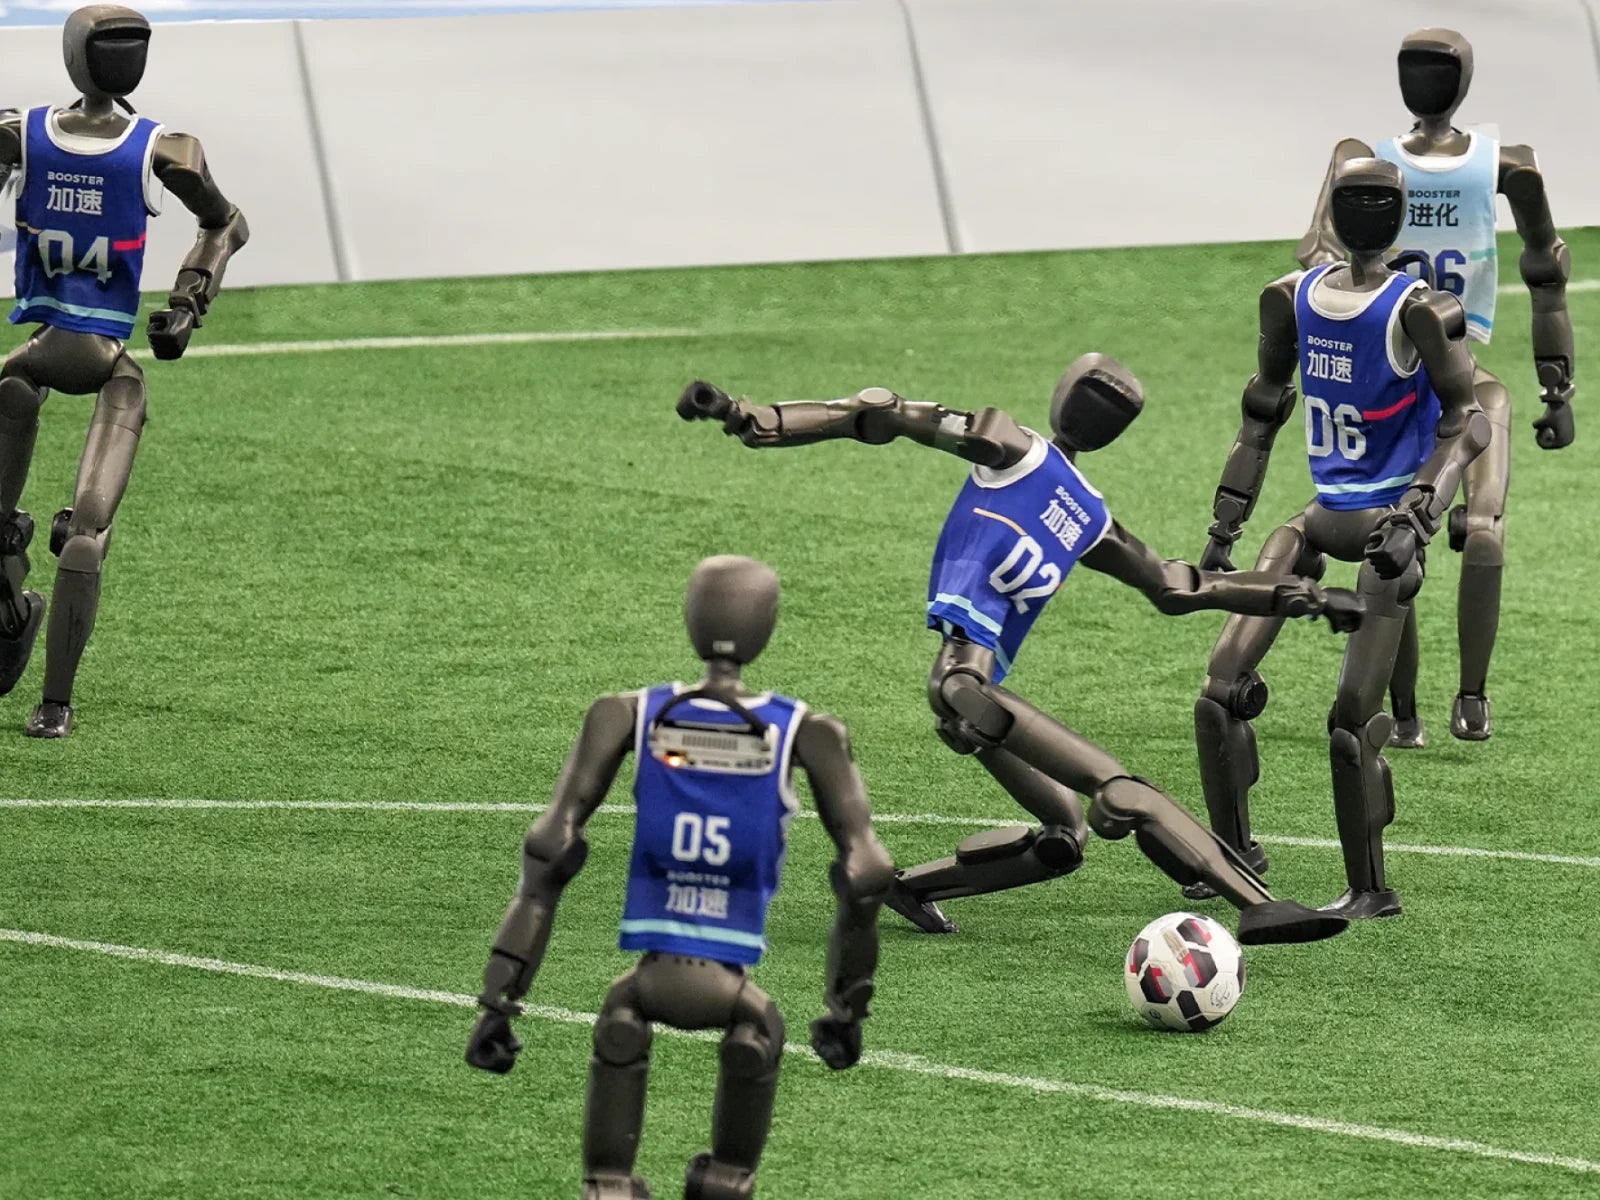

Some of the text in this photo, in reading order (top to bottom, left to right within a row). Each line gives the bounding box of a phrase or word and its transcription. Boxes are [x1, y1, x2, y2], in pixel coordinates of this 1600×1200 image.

[47, 170, 104, 186] BOOSTER
[1408, 190, 1461, 199] BOOSTER
[46, 184, 103, 216] 加速
[1408, 203, 1459, 227] 进化
[37, 229, 113, 285] 04
[1307, 335, 1353, 352] BOOSTER
[1306, 349, 1353, 383] 加速
[1304, 395, 1367, 461] 06
[1055, 485, 1091, 525] BOOSTER
[1039, 499, 1083, 551] 加速
[988, 535, 1061, 615] 02
[671, 812, 731, 866] 05
[665, 883, 729, 919] 加速
